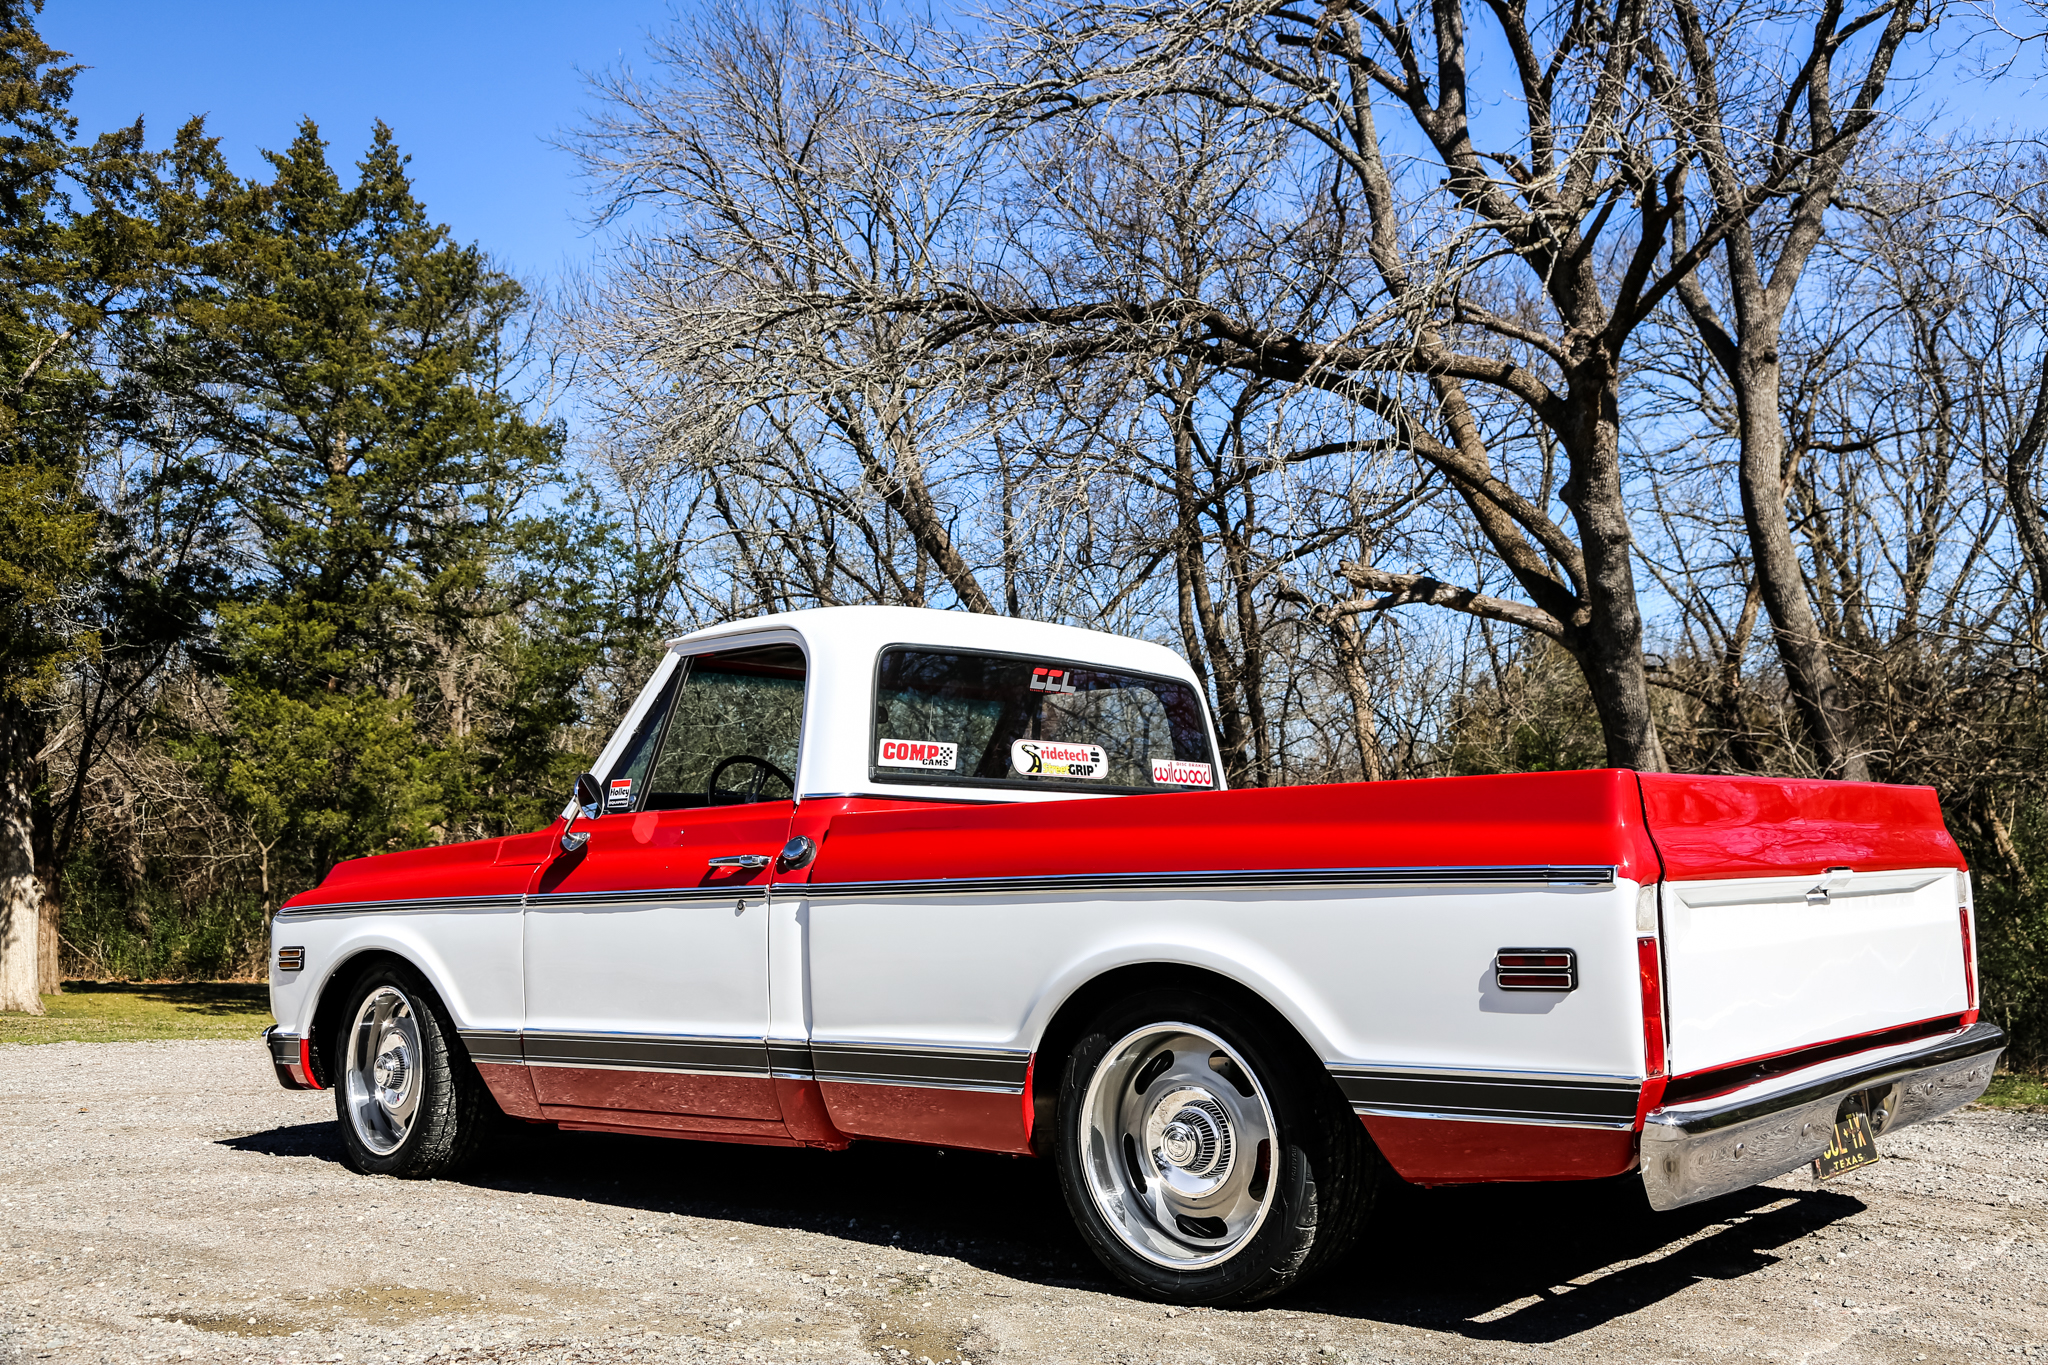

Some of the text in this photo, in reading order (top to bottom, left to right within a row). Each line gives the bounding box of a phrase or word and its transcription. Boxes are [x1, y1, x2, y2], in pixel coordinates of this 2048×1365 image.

[1030, 667, 1076, 693] CCL
[883, 742, 939, 761] COMP
[1041, 747, 1089, 762] ridetech
[922, 758, 949, 767] CAMS
[1154, 762, 1212, 785] wilwood
[610, 788, 629, 797] Holley
[1833, 1153, 1864, 1170] TEXAS
